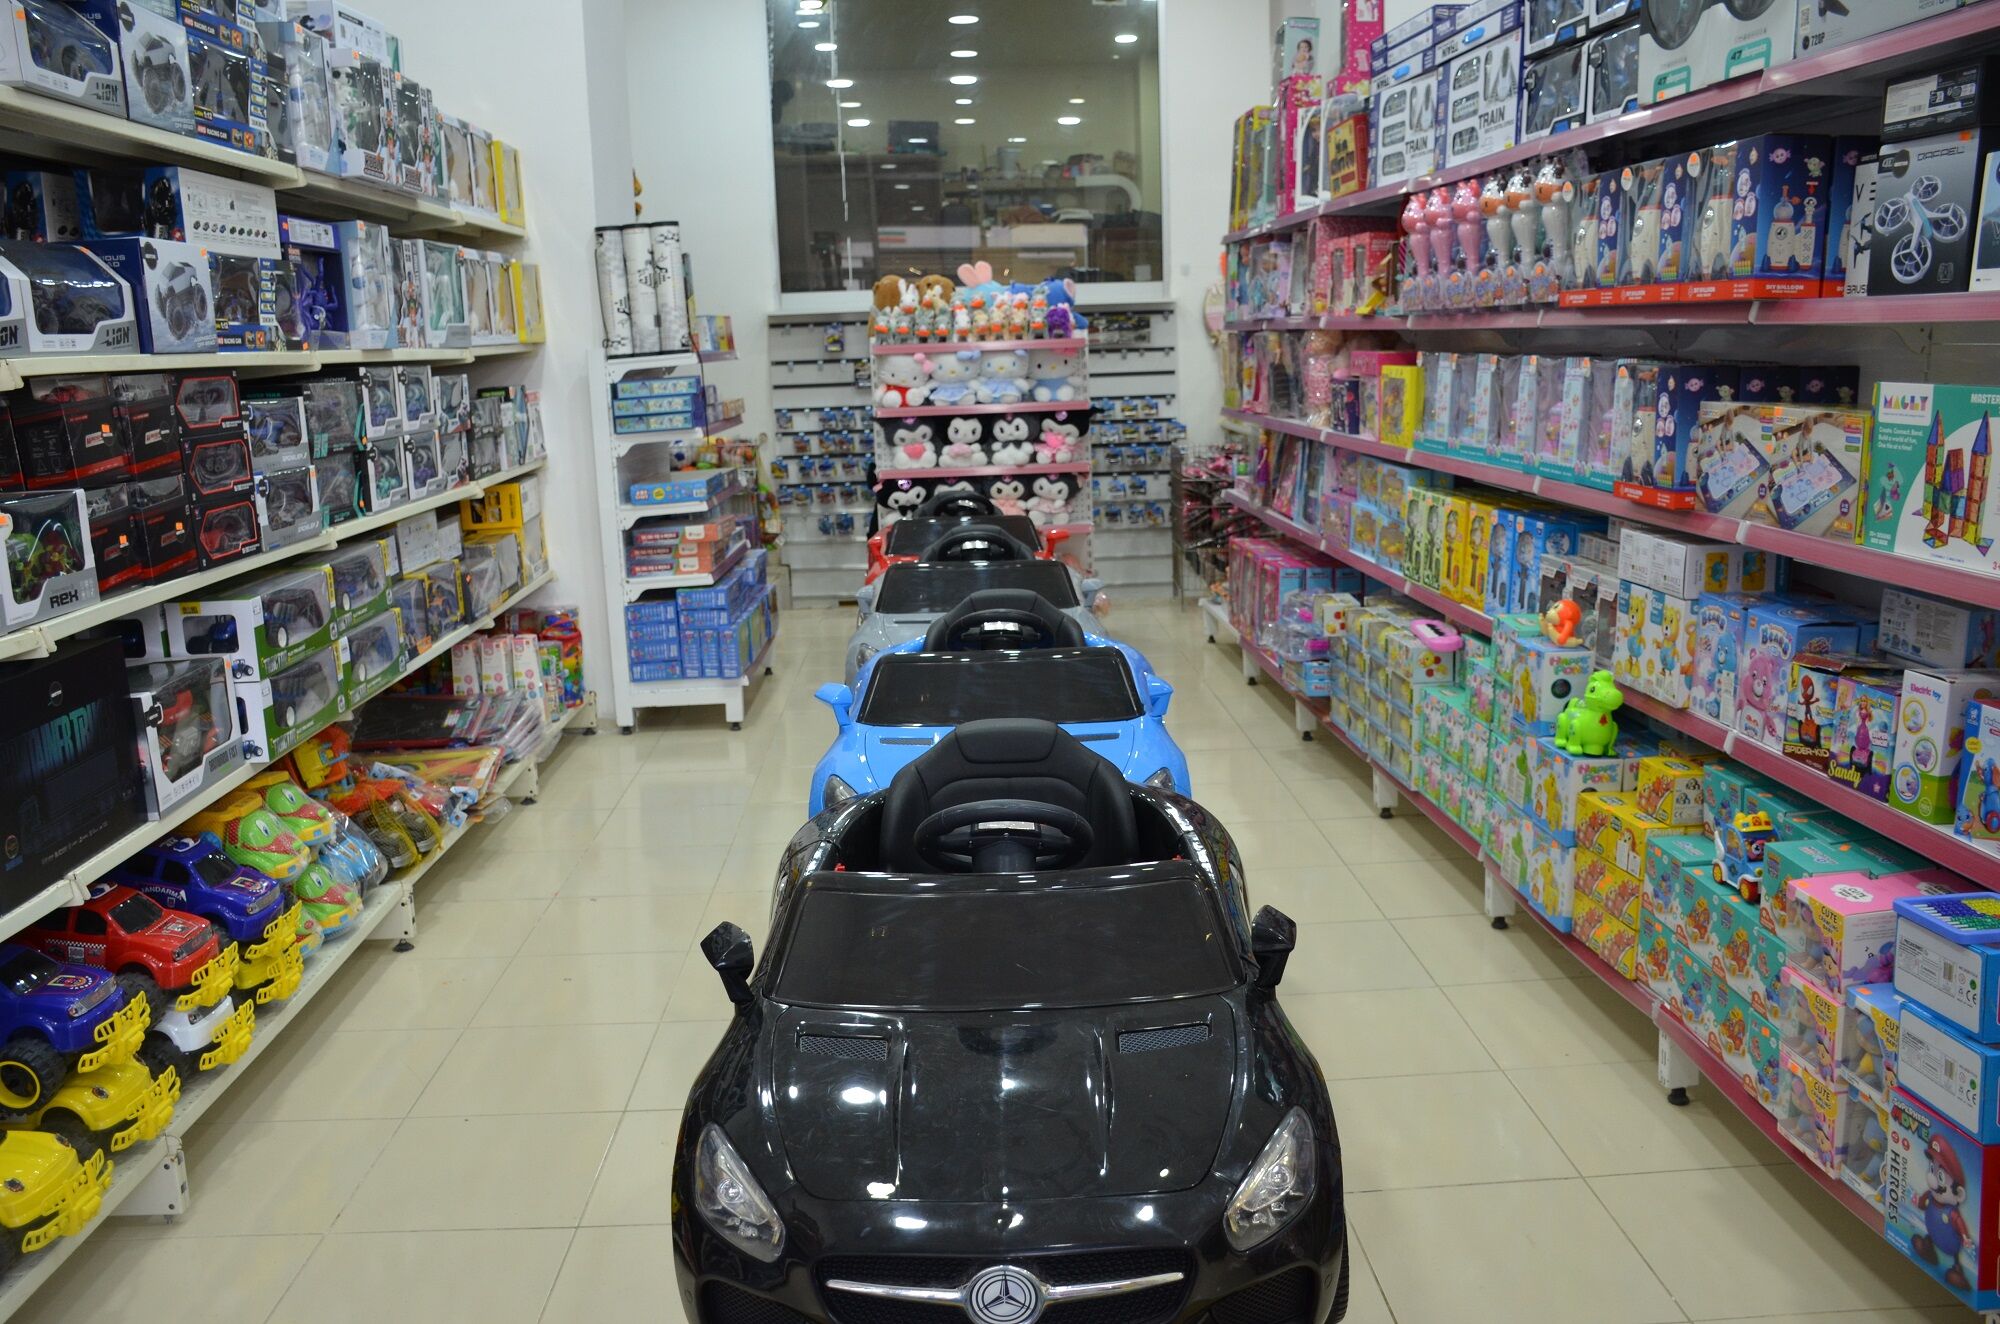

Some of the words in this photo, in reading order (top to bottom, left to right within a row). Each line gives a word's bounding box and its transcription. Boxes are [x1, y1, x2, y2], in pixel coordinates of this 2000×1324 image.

[95, 82, 118, 103] LION
[1478, 105, 1506, 129] TRAIN
[1405, 136, 1428, 155] TRAIN
[105, 327, 130, 347] LION
[1883, 395, 1928, 411] MAGLY
[1910, 683, 1931, 697] Electric
[1932, 689, 1942, 701] toy
[1784, 745, 1830, 757] SPIDER-KID
[1828, 759, 1862, 789] Sandy
[1821, 905, 1838, 923] CUTE
[1815, 995, 1831, 1013] CUTE
[1885, 1018, 1899, 1034] CUT
[1813, 1081, 1830, 1102] CUTE
[1892, 1097, 1931, 1127] SUPERHERO
[1891, 1104, 1930, 1144] MOVIE
[1888, 1149, 1901, 1224] HEROES
[1900, 1157, 1908, 1202] DANCING
